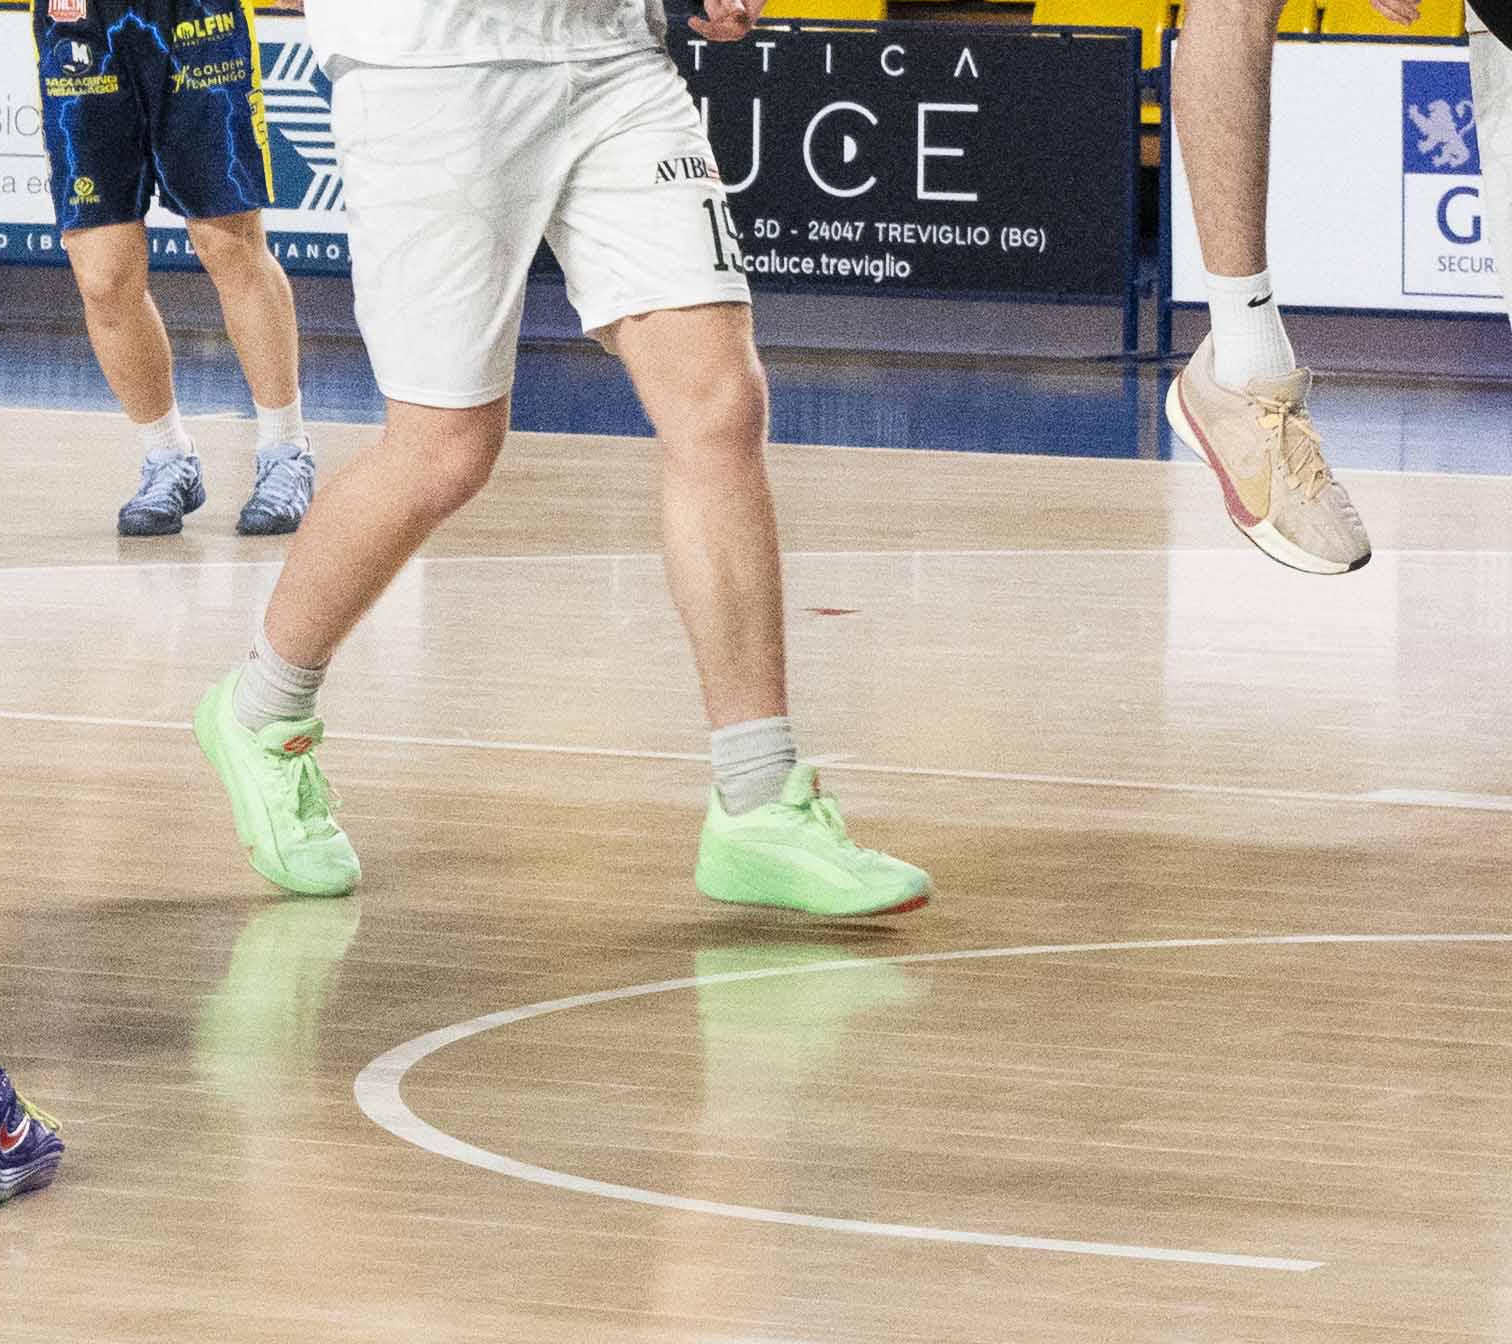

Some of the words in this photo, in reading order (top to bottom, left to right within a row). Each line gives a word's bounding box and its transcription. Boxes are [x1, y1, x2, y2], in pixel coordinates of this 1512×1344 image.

[193, 58, 244, 76] GOLDEN
[703, 96, 979, 203] UCE
[753, 218, 780, 238] 5D
[808, 221, 864, 242] 24047
[874, 222, 990, 246] TREVIGLIO
[1000, 225, 1047, 252] (BG)
